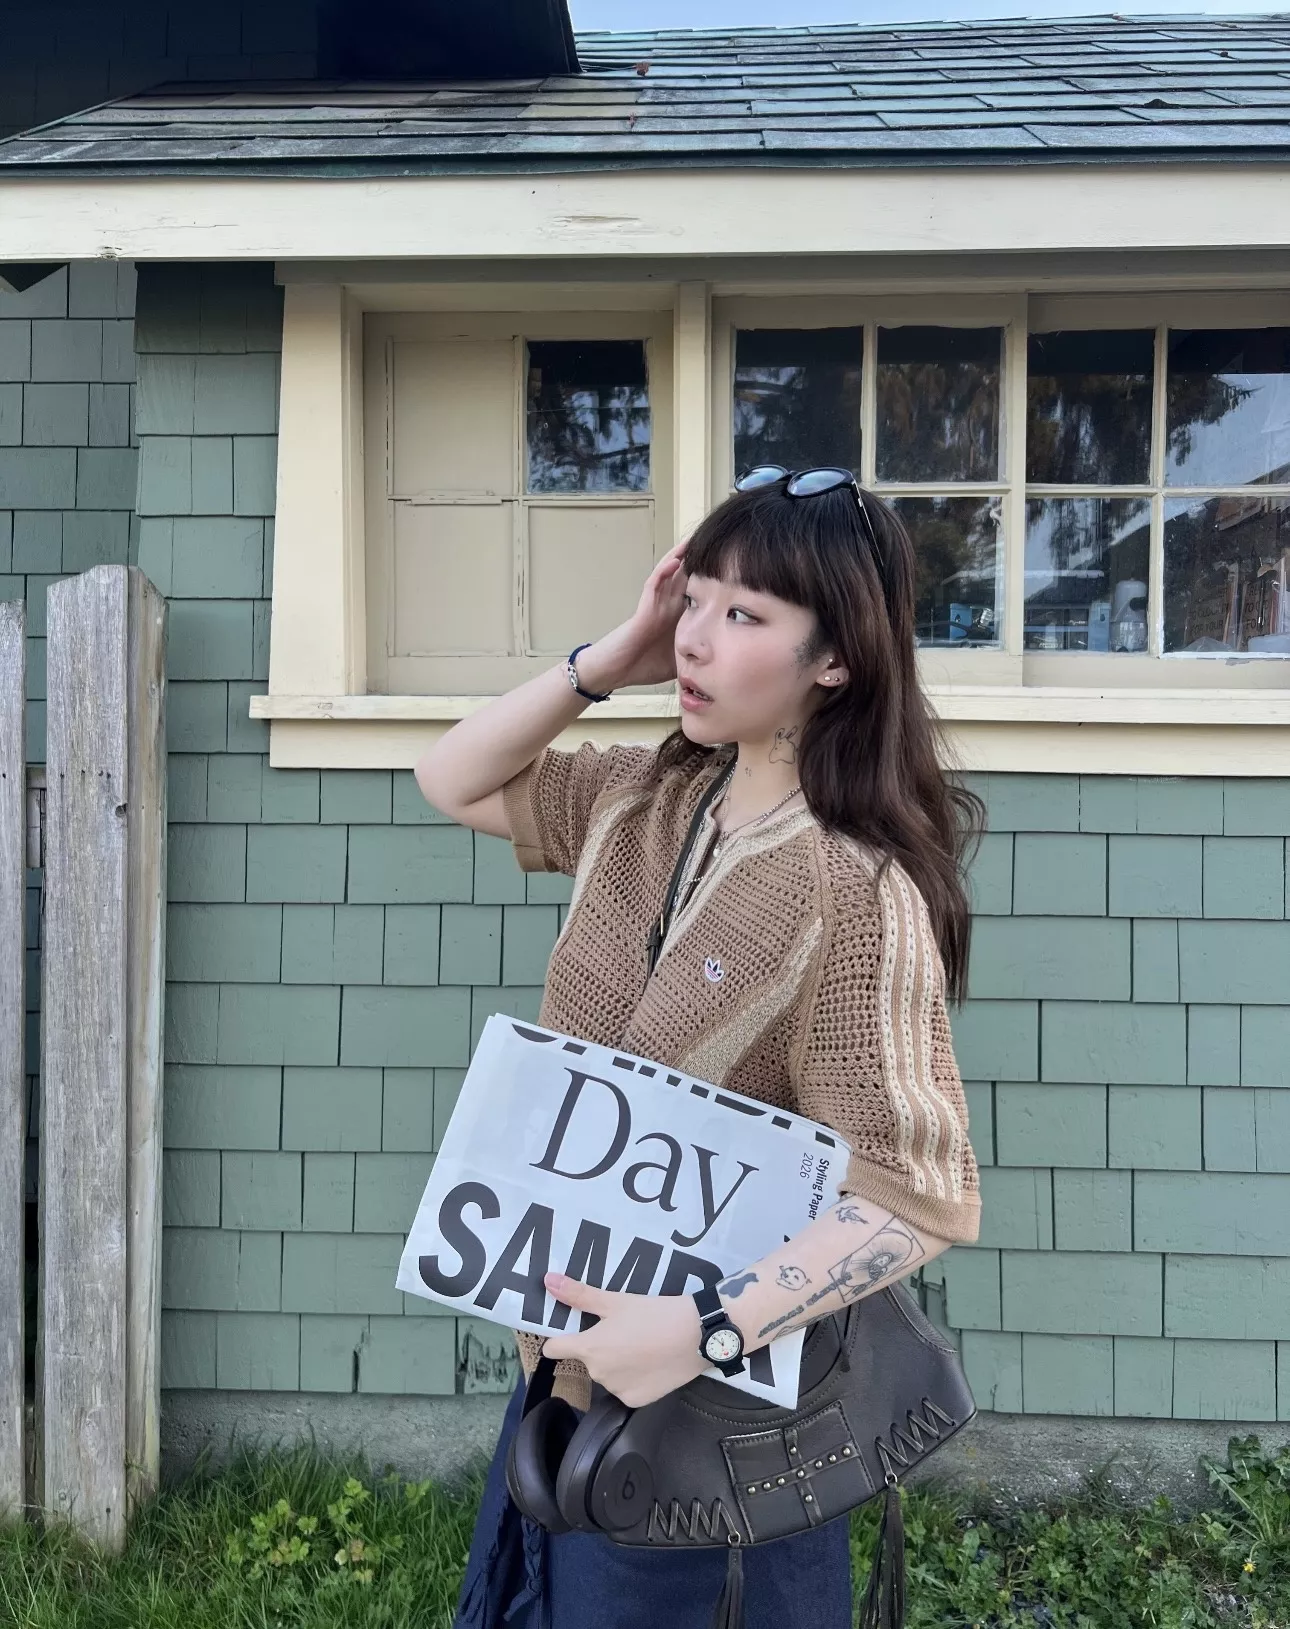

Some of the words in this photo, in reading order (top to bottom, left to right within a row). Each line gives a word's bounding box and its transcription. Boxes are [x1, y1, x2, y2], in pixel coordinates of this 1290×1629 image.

[529, 1067, 760, 1247] Day
[799, 1152, 814, 1179] 2026
[812, 1158, 830, 1192] Styling
[808, 1193, 823, 1220] Paper
